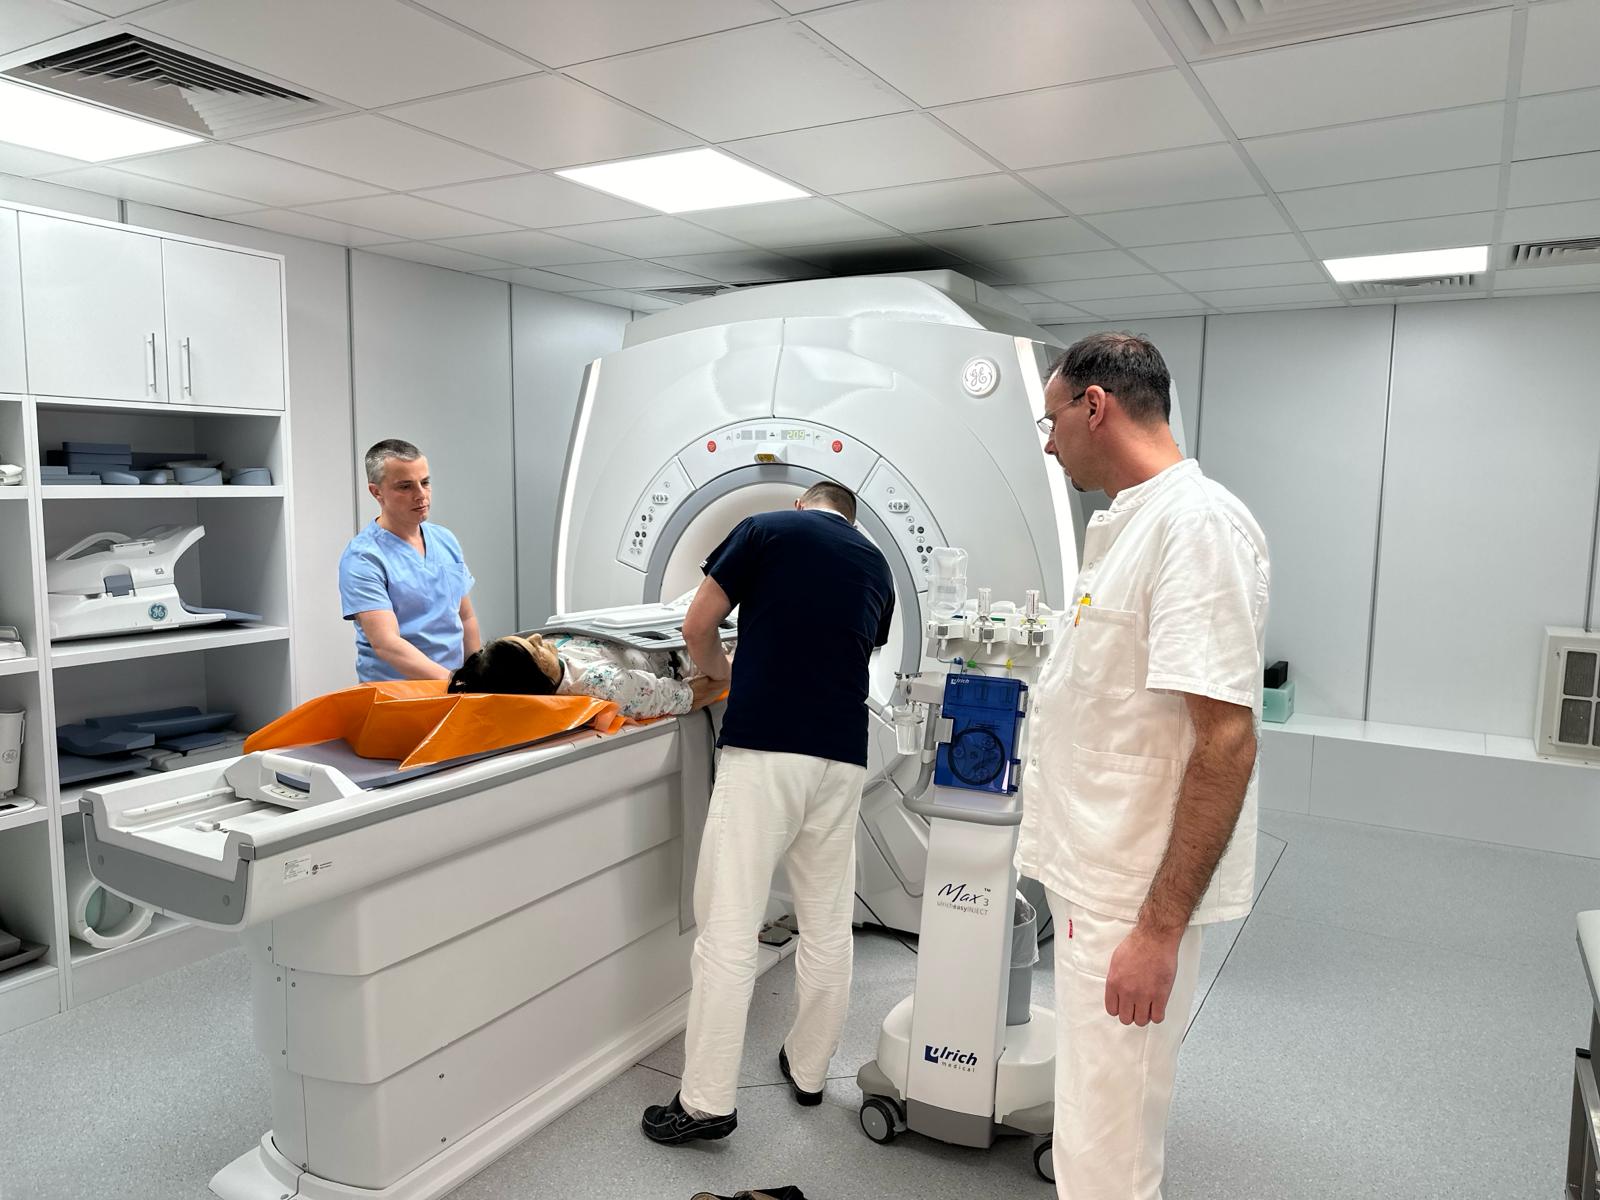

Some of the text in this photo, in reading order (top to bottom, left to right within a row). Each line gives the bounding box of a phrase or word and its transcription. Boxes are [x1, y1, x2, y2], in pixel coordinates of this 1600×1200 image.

[938, 883, 984, 904] Max
[925, 1045, 978, 1066] ulrich
[941, 1061, 975, 1072] medical
